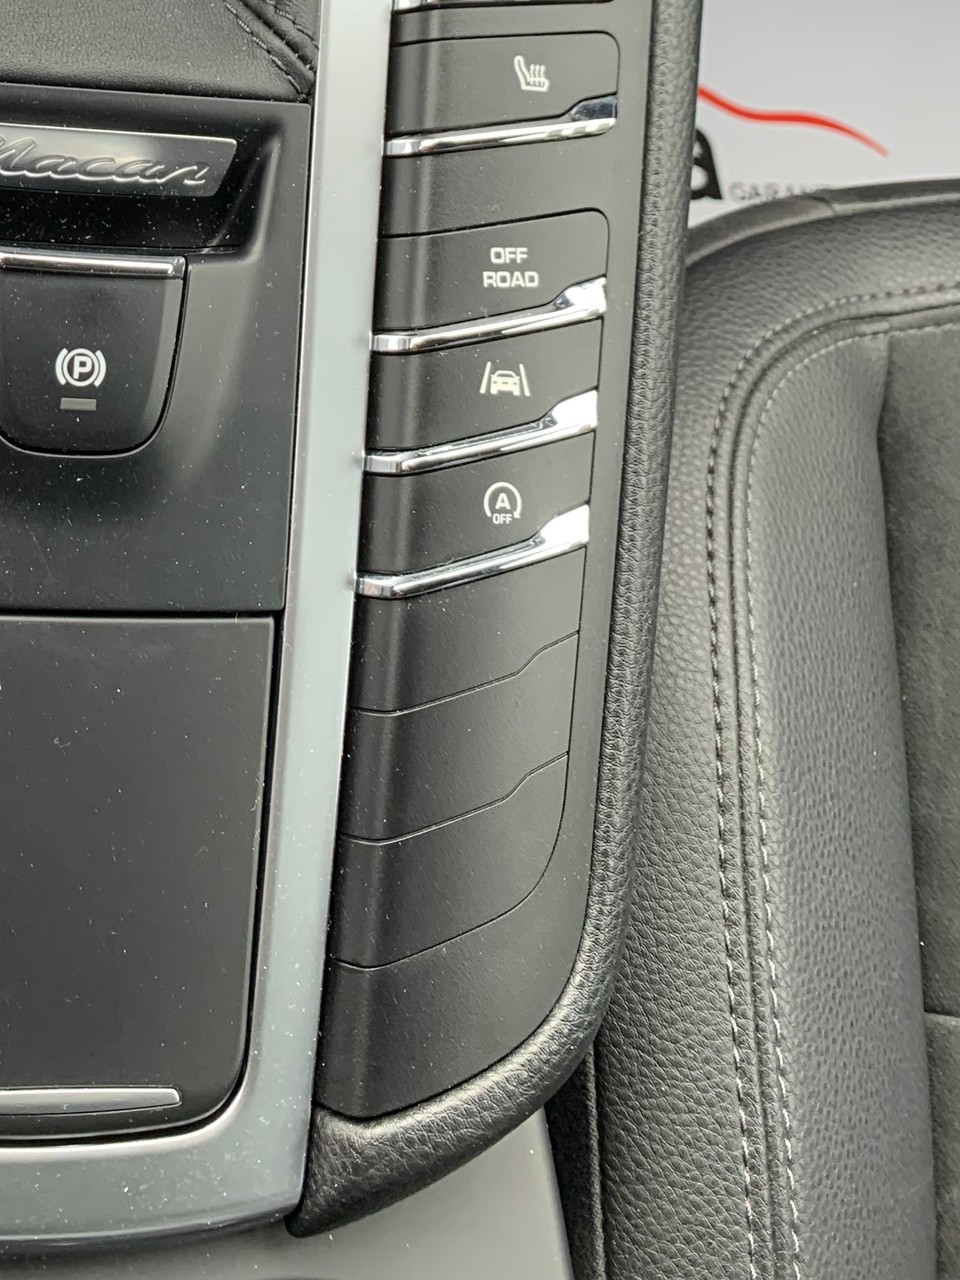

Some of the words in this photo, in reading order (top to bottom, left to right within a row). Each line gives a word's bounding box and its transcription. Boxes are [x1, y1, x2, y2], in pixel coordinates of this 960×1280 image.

[490, 247, 528, 264] OFF
[482, 271, 539, 288] ROAD
[492, 512, 513, 525] OFF
